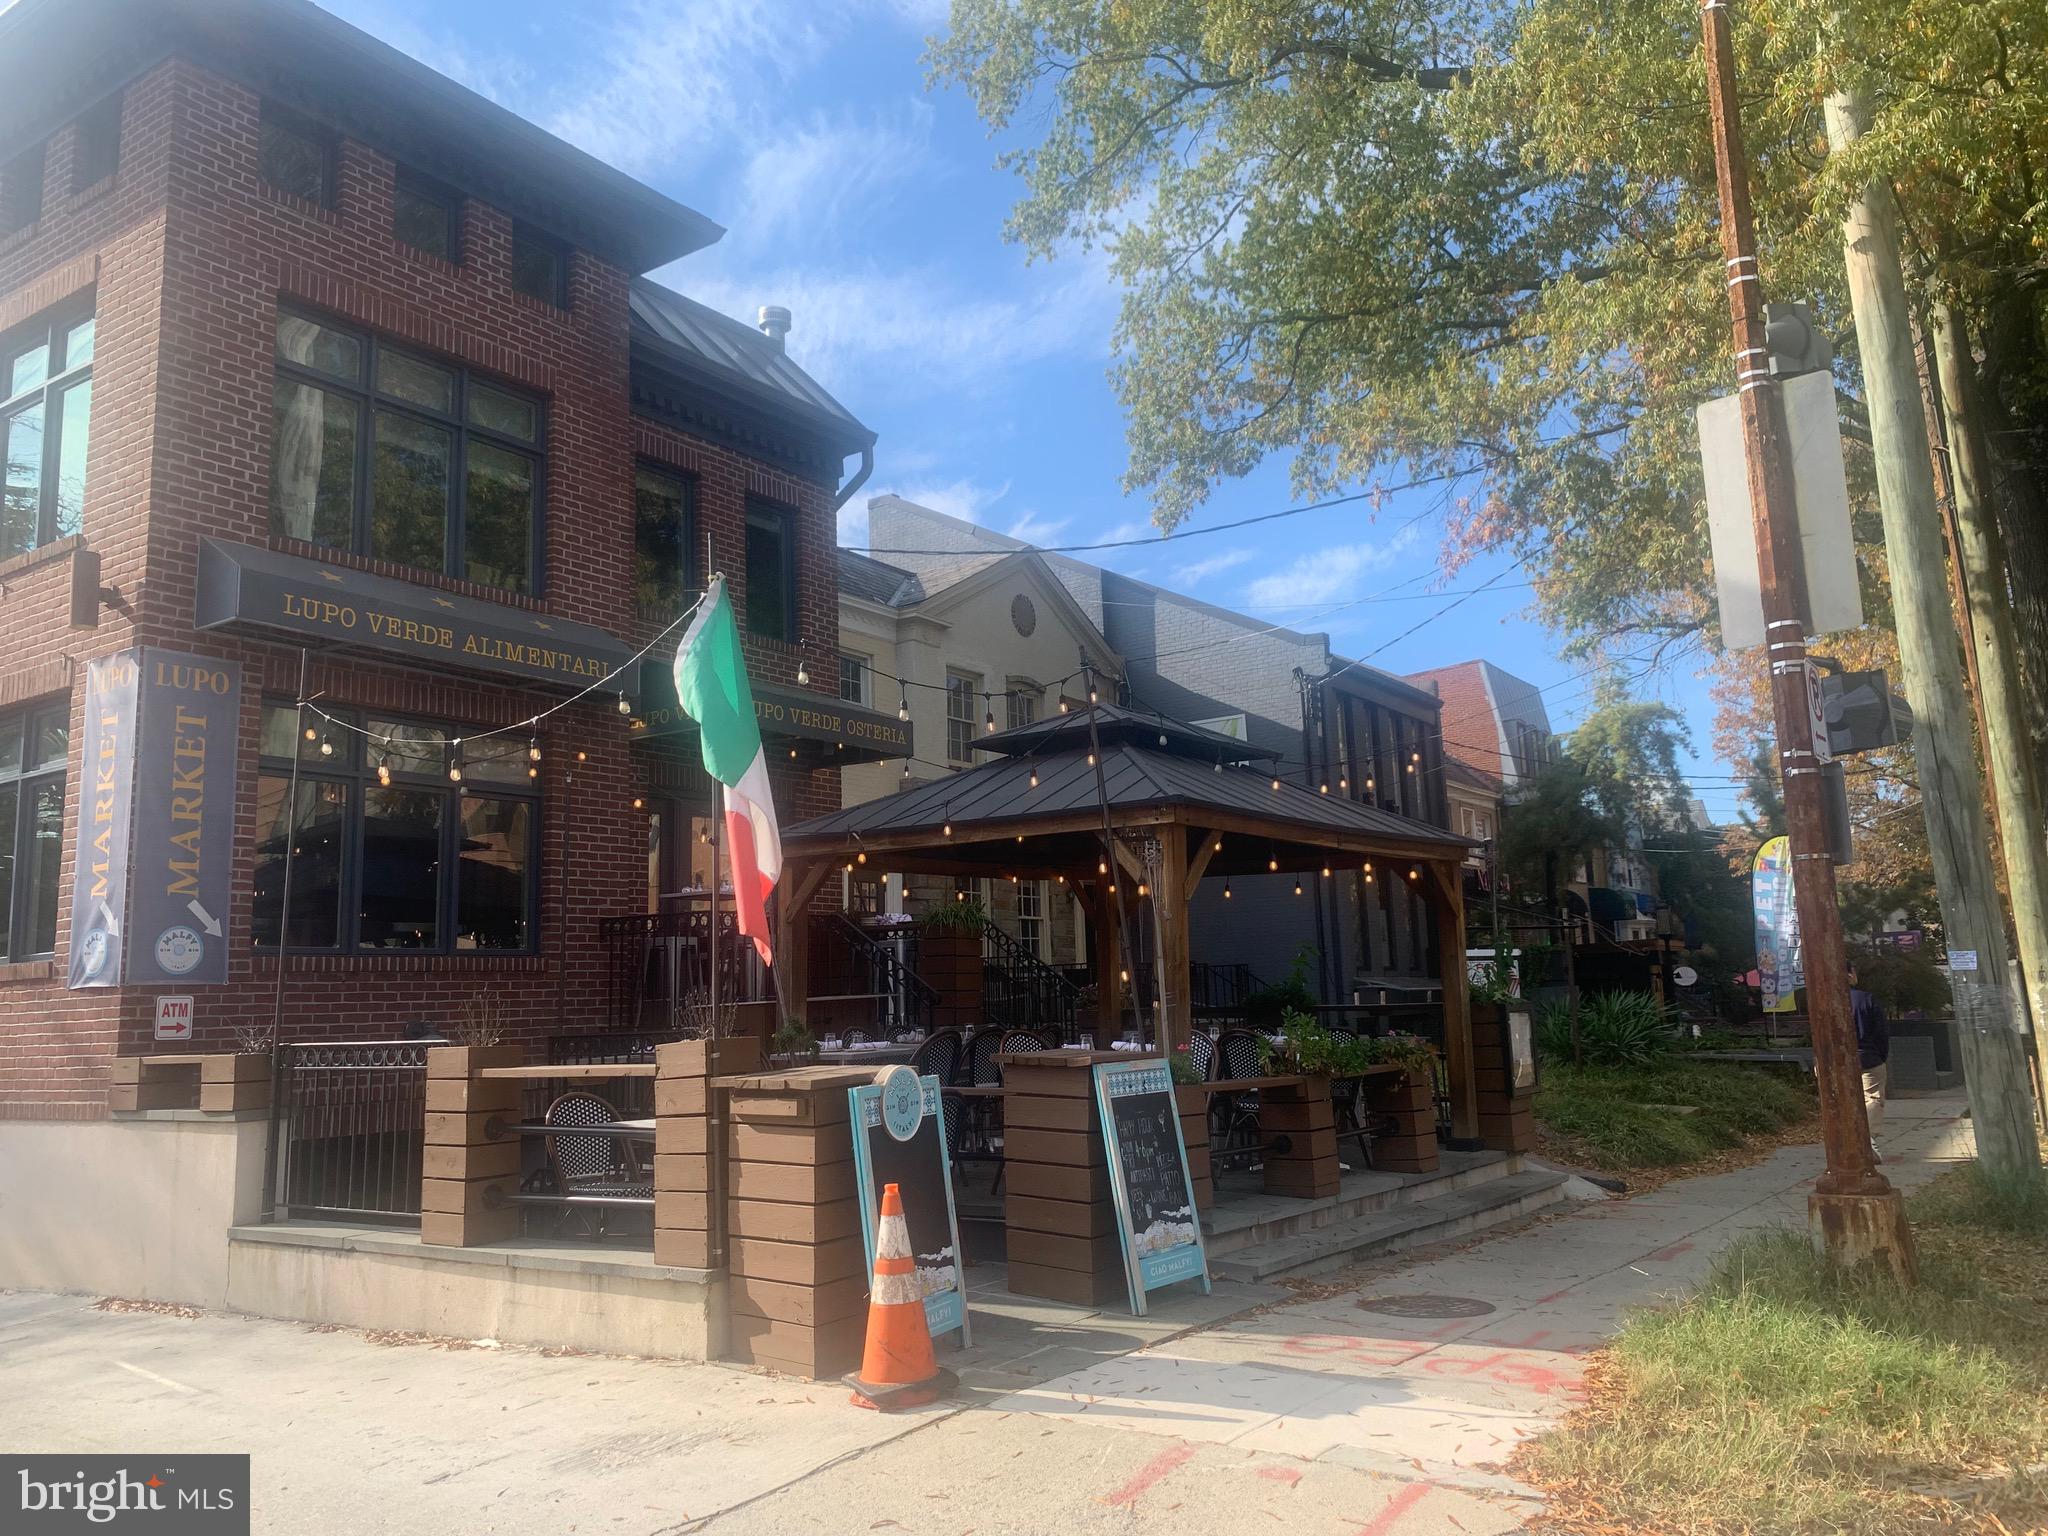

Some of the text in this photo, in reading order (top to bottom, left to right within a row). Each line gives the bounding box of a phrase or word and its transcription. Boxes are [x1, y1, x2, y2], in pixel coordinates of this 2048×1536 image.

[283, 593, 609, 679] LUPO VERDE ALIMENTARI
[91, 663, 134, 696] LUPO
[155, 661, 231, 696] LUPO
[753, 701, 908, 745] UPO VERDE OSTERIA
[90, 708, 119, 900] MARKET
[166, 704, 208, 899] MARKET
[162, 931, 198, 946] MALFY
[161, 1003, 189, 1018] ATM
[1150, 1256, 1193, 1277] CIAO MALFY!
[928, 1303, 952, 1325] ALFY!
